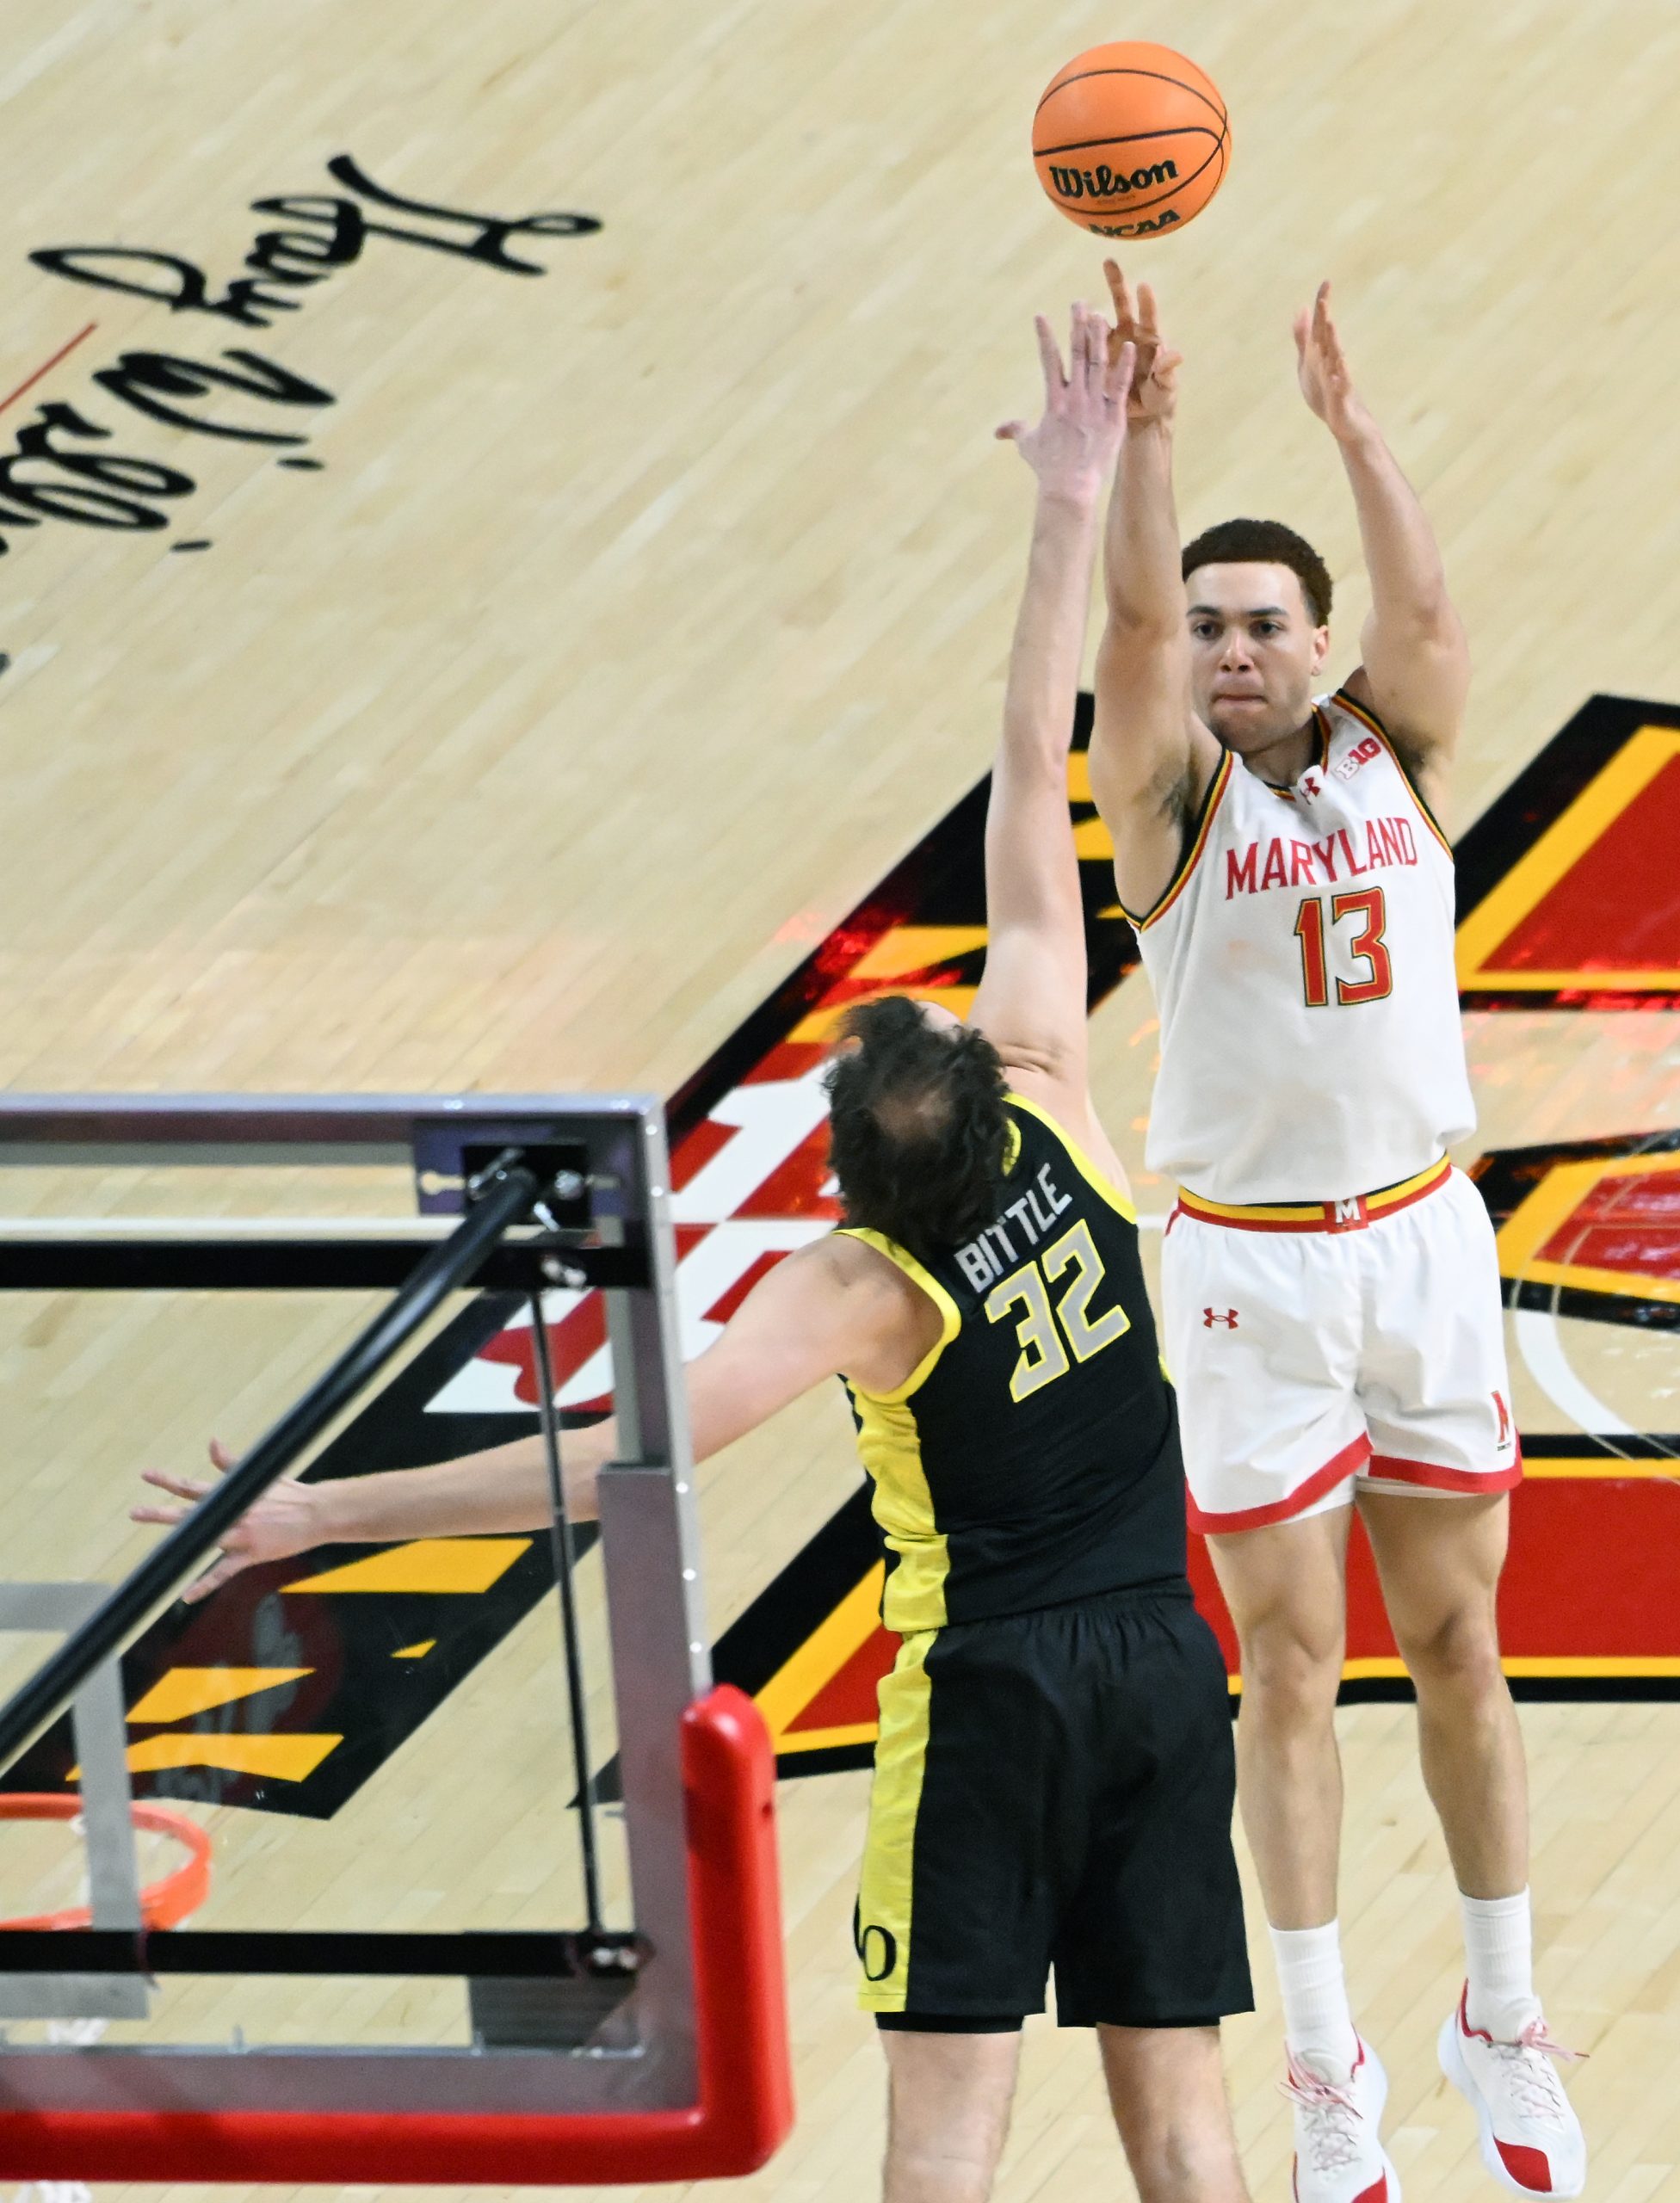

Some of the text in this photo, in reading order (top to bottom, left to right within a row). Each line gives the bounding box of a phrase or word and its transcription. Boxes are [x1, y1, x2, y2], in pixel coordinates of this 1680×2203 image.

[1048, 159, 1179, 199] Wilson
[1225, 817, 1418, 901] MARYLAND
[1294, 886, 1393, 1008] 13
[954, 1163, 1073, 1293] BITTLE
[1334, 1197, 1362, 1225] M
[984, 1219, 1131, 1403] 32
